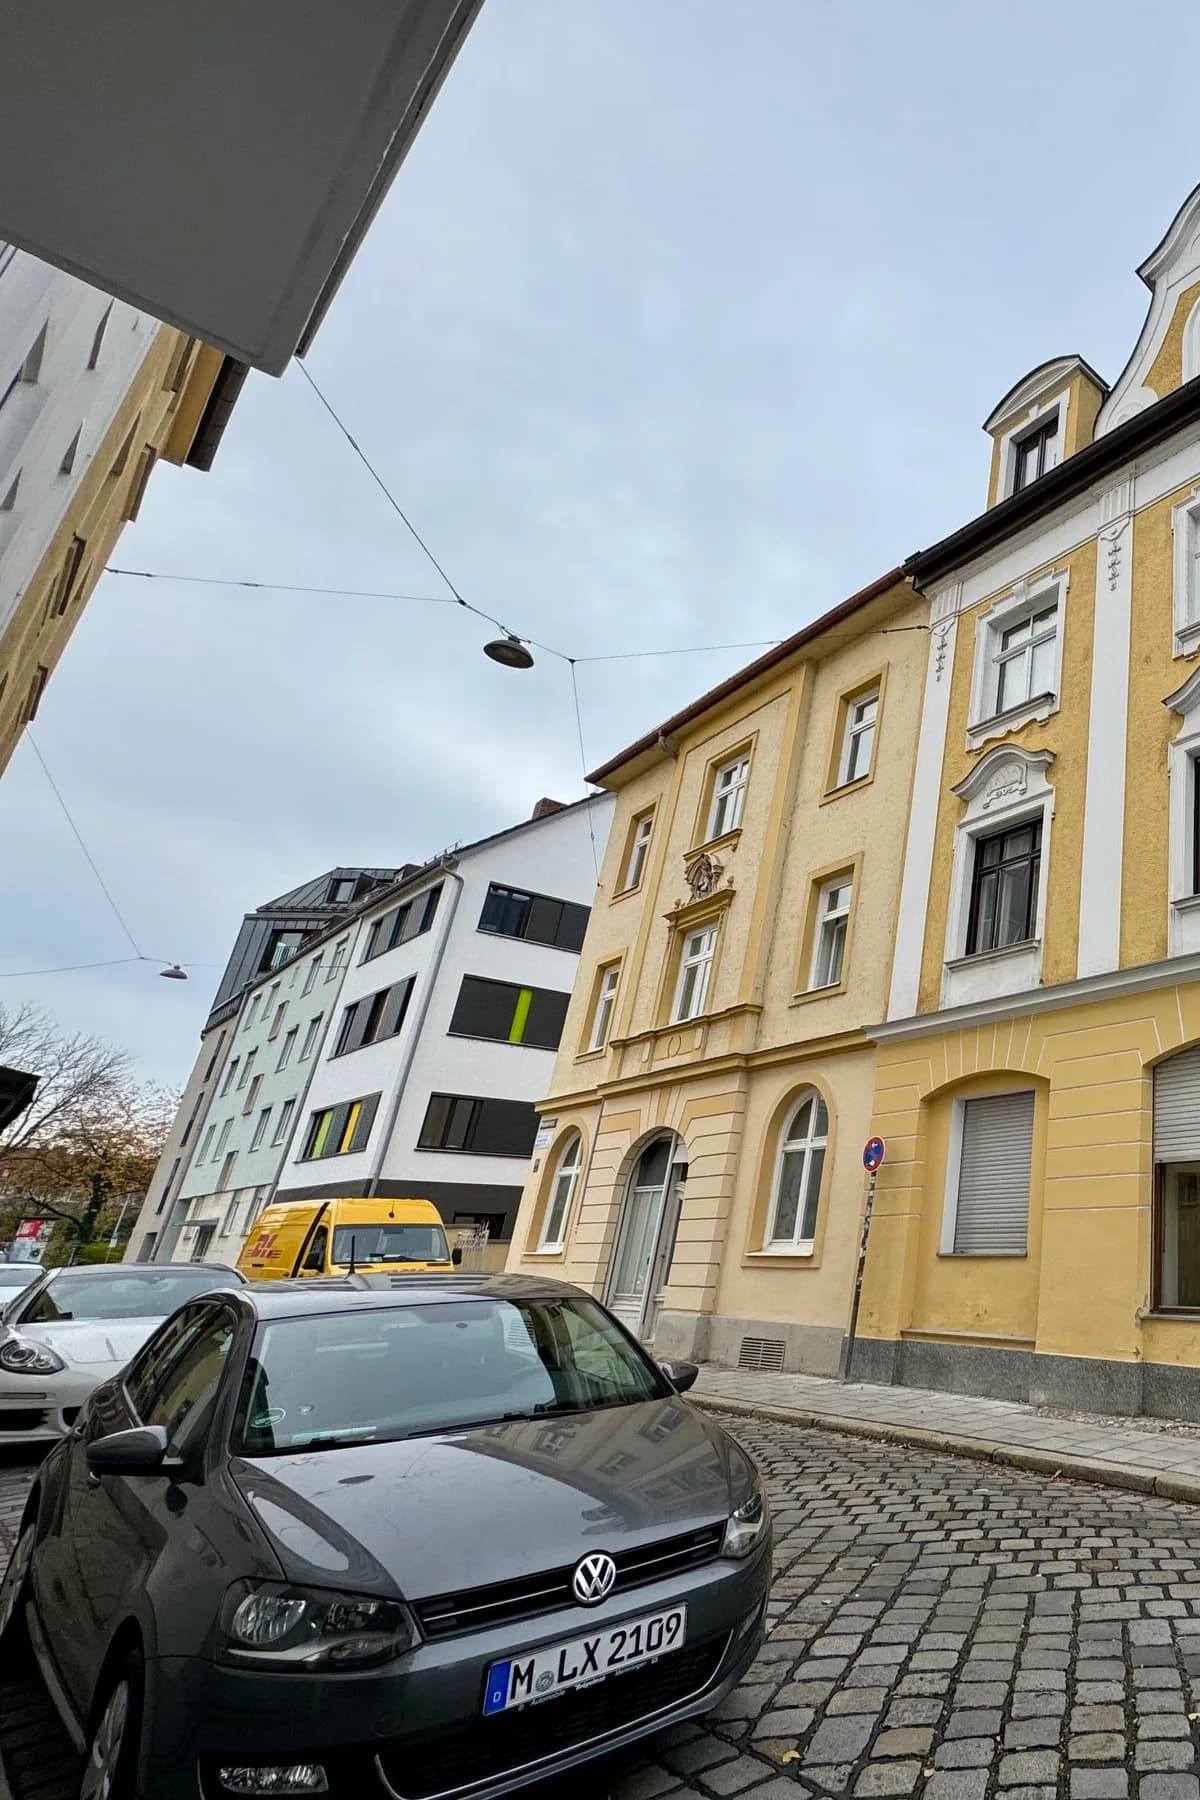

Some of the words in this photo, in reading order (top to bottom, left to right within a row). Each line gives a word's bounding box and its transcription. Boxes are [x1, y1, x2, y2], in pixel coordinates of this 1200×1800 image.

[493, 1691, 501, 1703] D
[511, 1658, 535, 1699] M
[557, 1637, 601, 1683] LX
[607, 1612, 682, 1667] 2109
